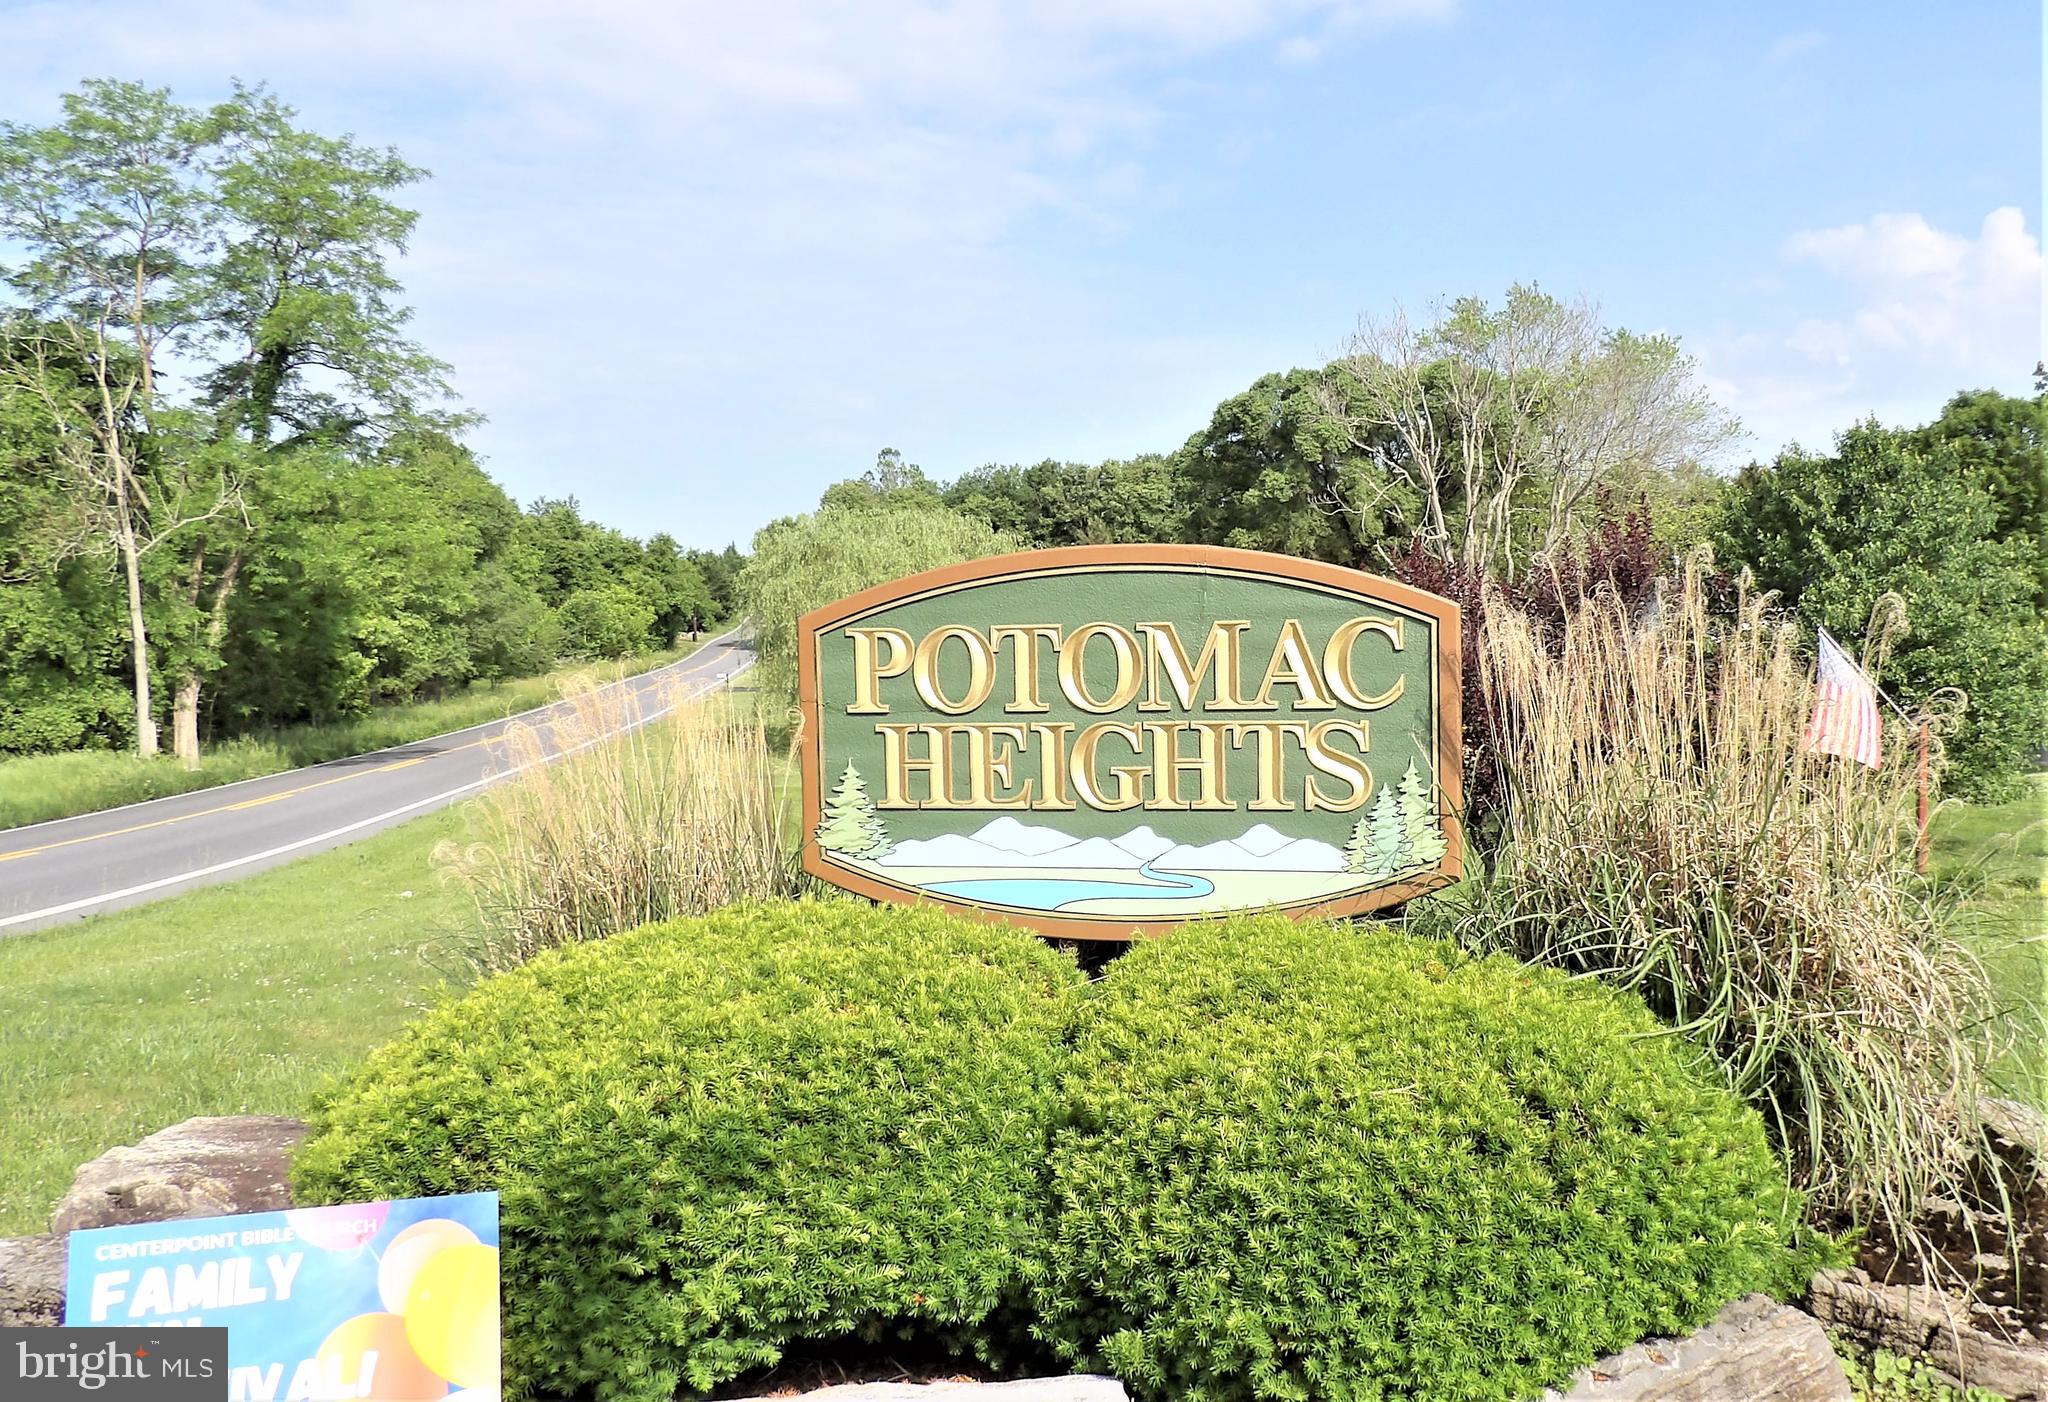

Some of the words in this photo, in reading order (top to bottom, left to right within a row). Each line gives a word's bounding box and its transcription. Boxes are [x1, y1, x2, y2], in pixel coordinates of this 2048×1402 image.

[844, 616, 1405, 715] POTOMAC
[875, 719, 1373, 812] HEIGHTS
[95, 1231, 238, 1261] CENTERPOINT
[240, 1227, 297, 1247] BIBLE
[90, 1252, 304, 1322] FAMILY
